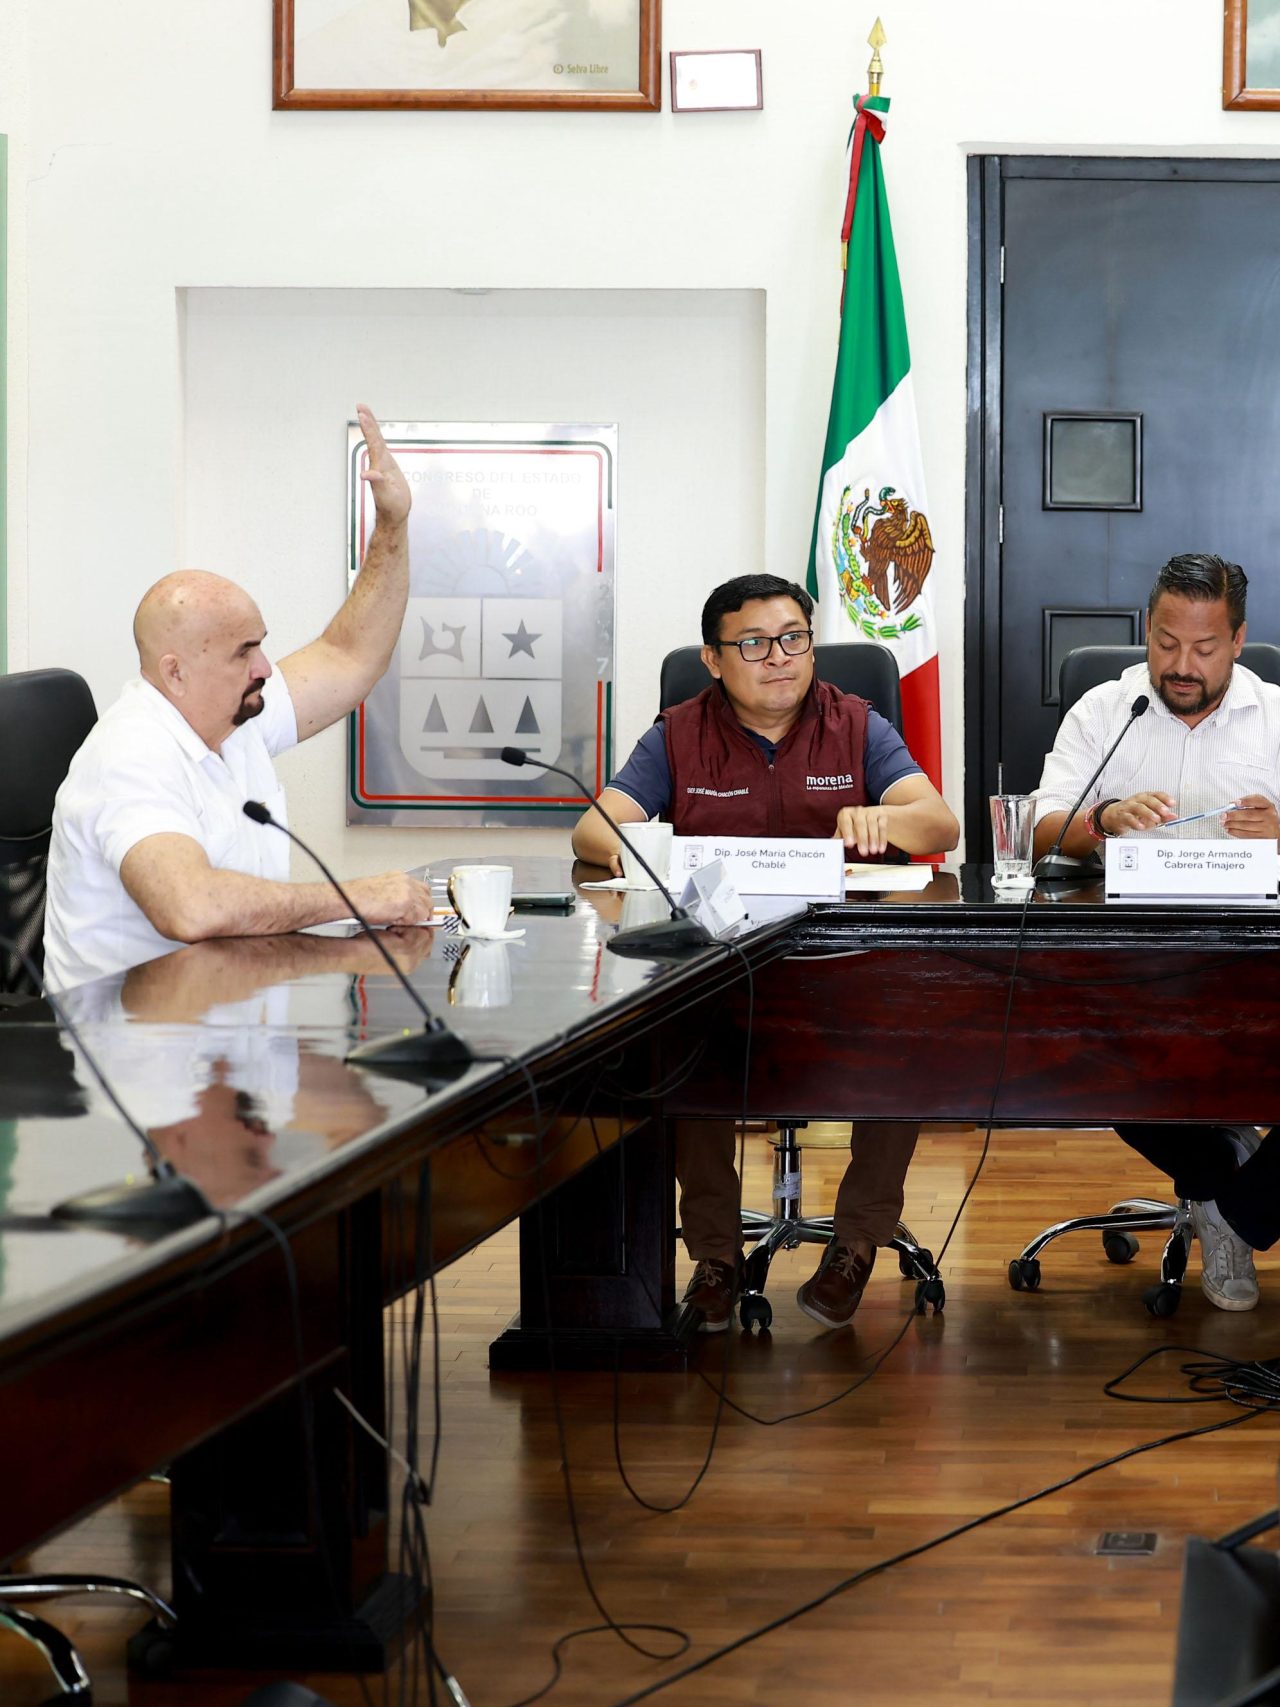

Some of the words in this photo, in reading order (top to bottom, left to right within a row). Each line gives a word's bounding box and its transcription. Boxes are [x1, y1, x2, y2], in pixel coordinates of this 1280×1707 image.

[567, 64, 587, 74] Selva
[589, 64, 609, 74] Libre
[522, 472, 582, 484] ESTADO
[473, 488, 491, 500] DE
[505, 504, 537, 517] ROO
[806, 774, 853, 785] morena
[714, 848, 733, 859] Dip.
[735, 848, 757, 857] José
[759, 849, 786, 858] María
[788, 849, 825, 858] Chacón
[1157, 849, 1176, 860] Dip.
[1178, 849, 1205, 860] Jorge
[1207, 850, 1253, 859] Armando
[752, 860, 786, 869] Chablé
[1164, 861, 1203, 869] Cabrera
[1205, 861, 1245, 871] Tinajero
